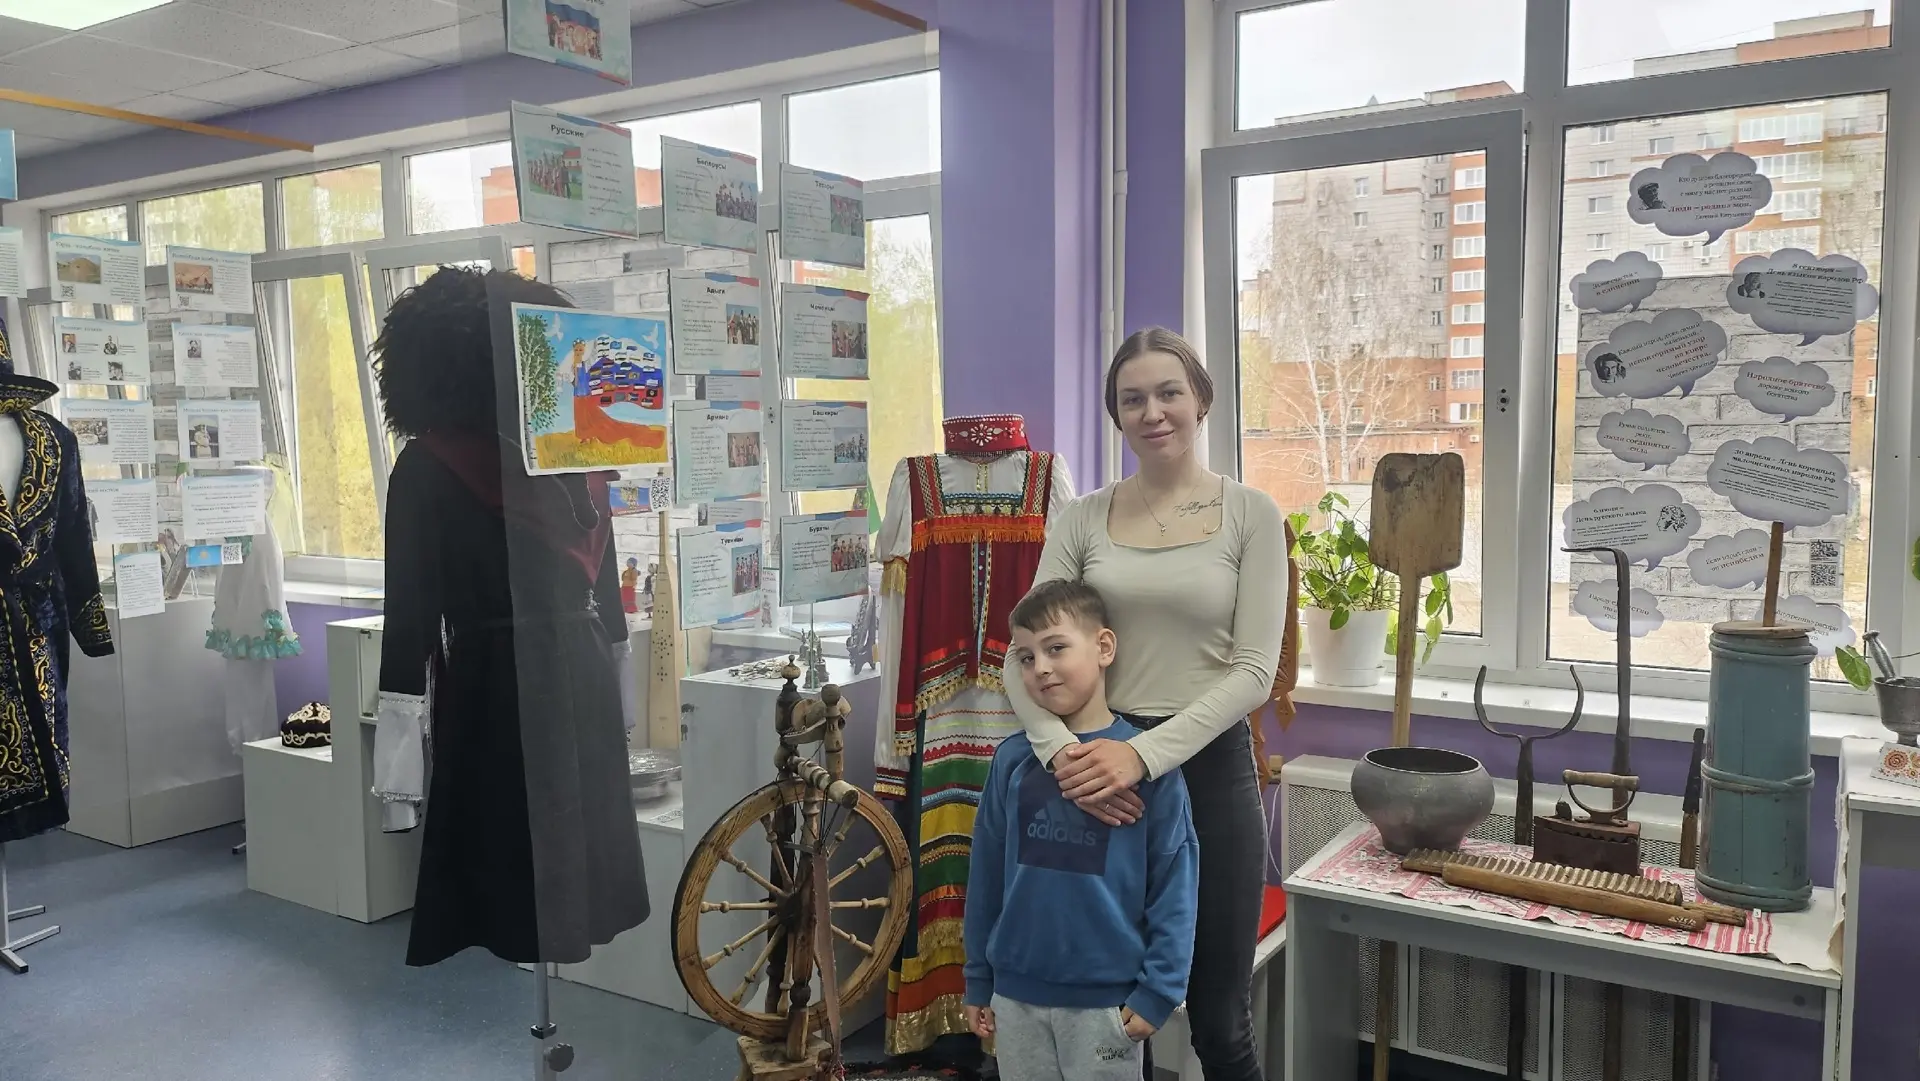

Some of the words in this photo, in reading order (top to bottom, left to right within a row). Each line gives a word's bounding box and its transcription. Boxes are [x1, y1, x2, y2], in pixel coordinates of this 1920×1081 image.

[551, 124, 584, 138] Русские
[1766, 268, 1786, 276] День
[1628, 343, 1686, 368] неповторимый
[1687, 336, 1706, 347] узор
[1685, 344, 1708, 355] ковре
[1746, 372, 1787, 384] Народное
[1789, 379, 1826, 390] братство
[1732, 456, 1790, 474] малочисленных
[1792, 470, 1822, 480] народов
[1745, 452, 1771, 461] апреля
[1779, 458, 1797, 467] День
[1799, 464, 1836, 476] коренных
[1720, 553, 1764, 569] непобедим
[1028, 818, 1097, 846] adidas
